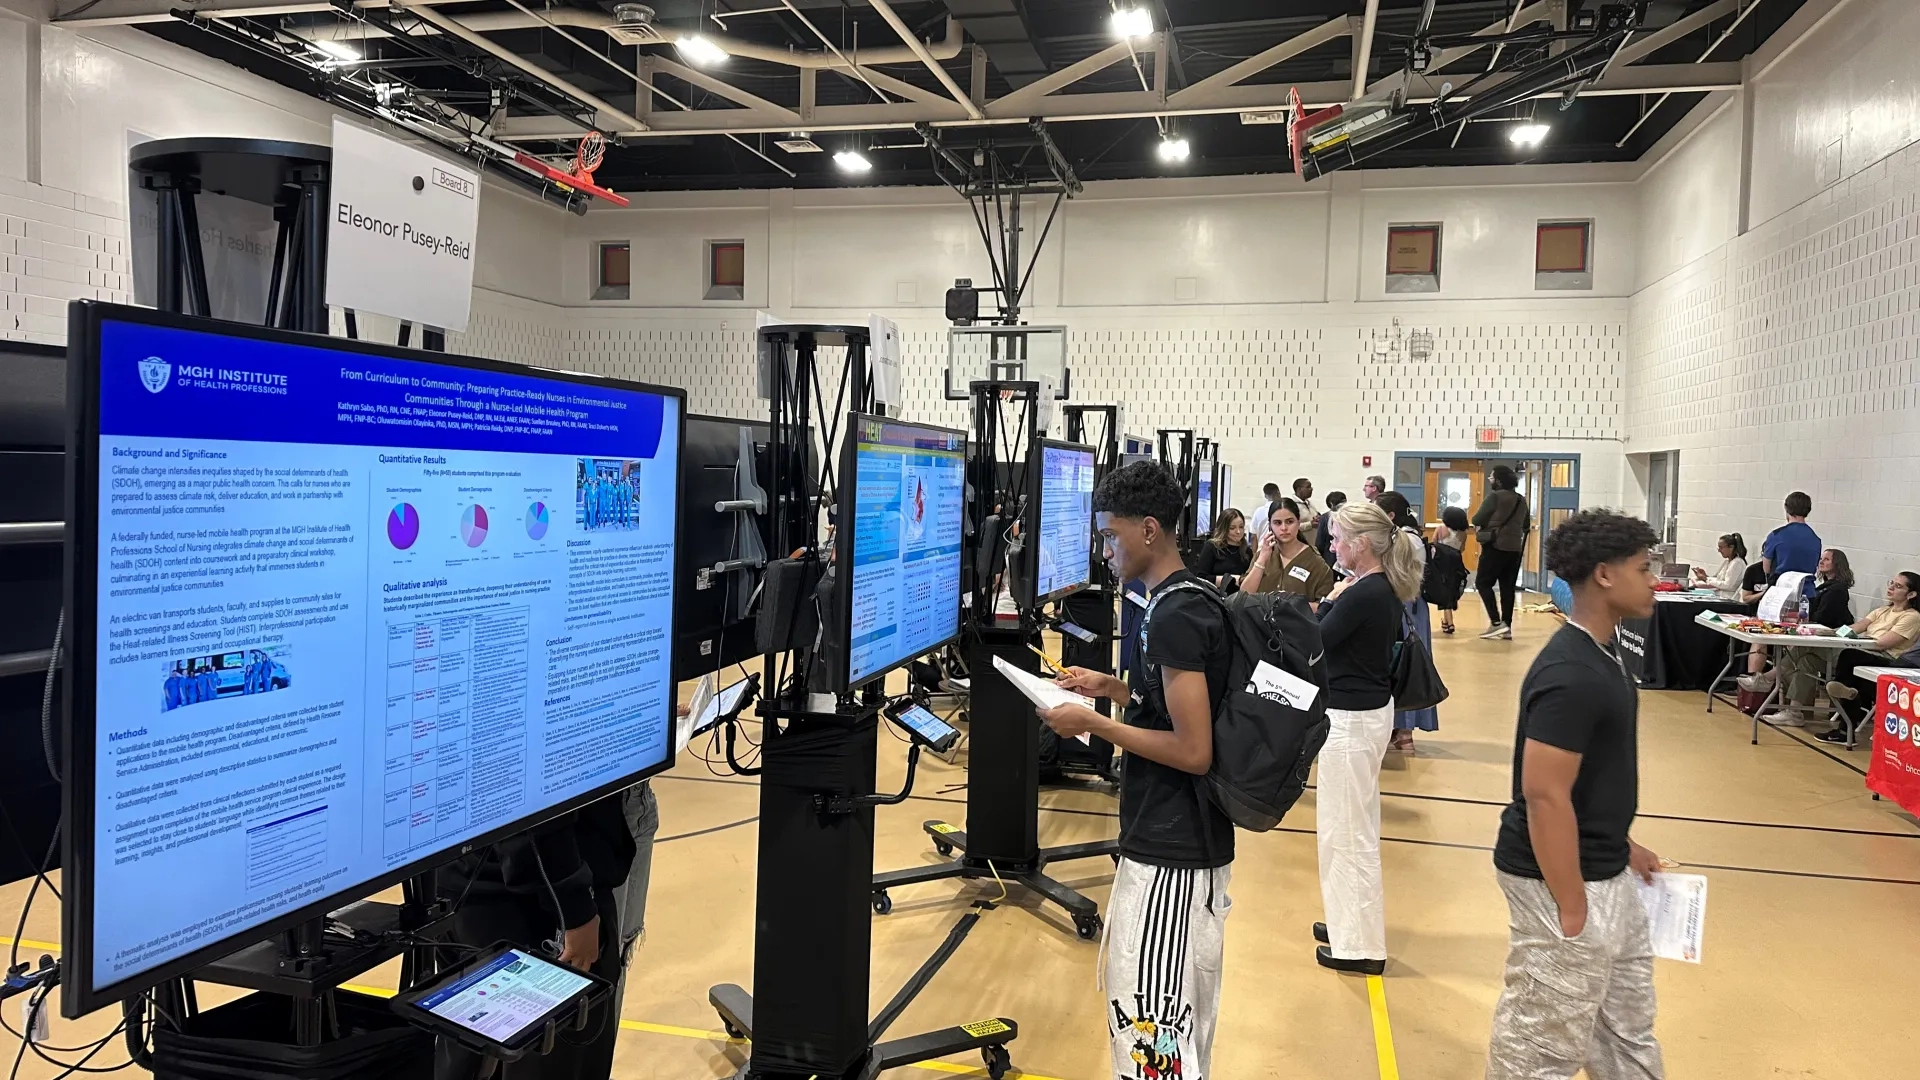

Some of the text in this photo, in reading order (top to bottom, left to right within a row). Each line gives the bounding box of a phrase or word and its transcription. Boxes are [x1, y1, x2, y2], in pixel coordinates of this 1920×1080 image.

[440, 173, 468, 193] Board 8
[338, 203, 470, 260] Eleonor Pusey-Reid
[178, 365, 288, 386] MGH INSTITUTE
[178, 378, 288, 395] OF HEALTH PROFESSIONS
[341, 368, 626, 409] From Curriculum to Community: Preparing Practice-Ready Nurses in Environmental Justice
[338, 402, 359, 412] Kathryn
[428, 409, 446, 417] Eleonor
[405, 393, 454, 406] Communities
[455, 398, 483, 411] Through
[490, 401, 522, 412] Nurse-Led
[524, 404, 544, 414] Mobile
[546, 406, 564, 416] Health
[565, 408, 588, 420] Program
[377, 417, 412, 426] Oluwatomisin
[113, 448, 162, 459] Background
[182, 450, 227, 459] Significance
[379, 454, 446, 464] Quantitative Results
[112, 466, 139, 474] Climate
[141, 466, 166, 477] change
[167, 466, 200, 475] intensifies
[202, 467, 231, 477] inequities
[232, 468, 254, 477] shaped
[255, 468, 262, 477] by
[112, 478, 142, 489] (SDOH),
[144, 479, 176, 489] emerging
[193, 479, 211, 489] major
[212, 479, 230, 489] public
[112, 492, 143, 502] prepared
[179, 491, 202, 499] climate
[203, 491, 216, 501] risk,
[239, 491, 269, 500] education,
[302, 491, 331, 500] partnership
[112, 505, 224, 515] environmental justice communities
[111, 533, 116, 541] A
[118, 532, 148, 542] federally
[149, 531, 175, 540] funded,
[176, 530, 207, 538] nurse-led
[208, 529, 228, 537] mobile
[230, 528, 248, 536] health
[249, 529, 273, 537] program
[111, 546, 152, 555] Professions
[154, 544, 177, 553] School
[178, 544, 185, 552] of
[186, 543, 211, 552] Nursing
[212, 542, 242, 551] integrates
[265, 540, 286, 548] change
[315, 536, 347, 544] determinants
[111, 560, 132, 569] health
[134, 558, 162, 570] (SDOH)
[163, 557, 188, 566] content
[202, 554, 238, 563] coursework
[239, 553, 250, 561] and
[257, 552, 288, 562] preparatory
[290, 550, 308, 558] clinical
[111, 572, 150, 582] culminating
[152, 571, 158, 580] in
[170, 568, 207, 580] experiential
[208, 566, 233, 576] learning
[234, 565, 254, 574] activity
[111, 580, 223, 596] environmental justice communities
[383, 578, 447, 592] Qualitative analysis
[546, 636, 572, 646] Conclusion
[1282, 689, 1300, 700] Annual
[109, 726, 147, 741] Methods
[1108, 994, 1193, 1042] ALLE
